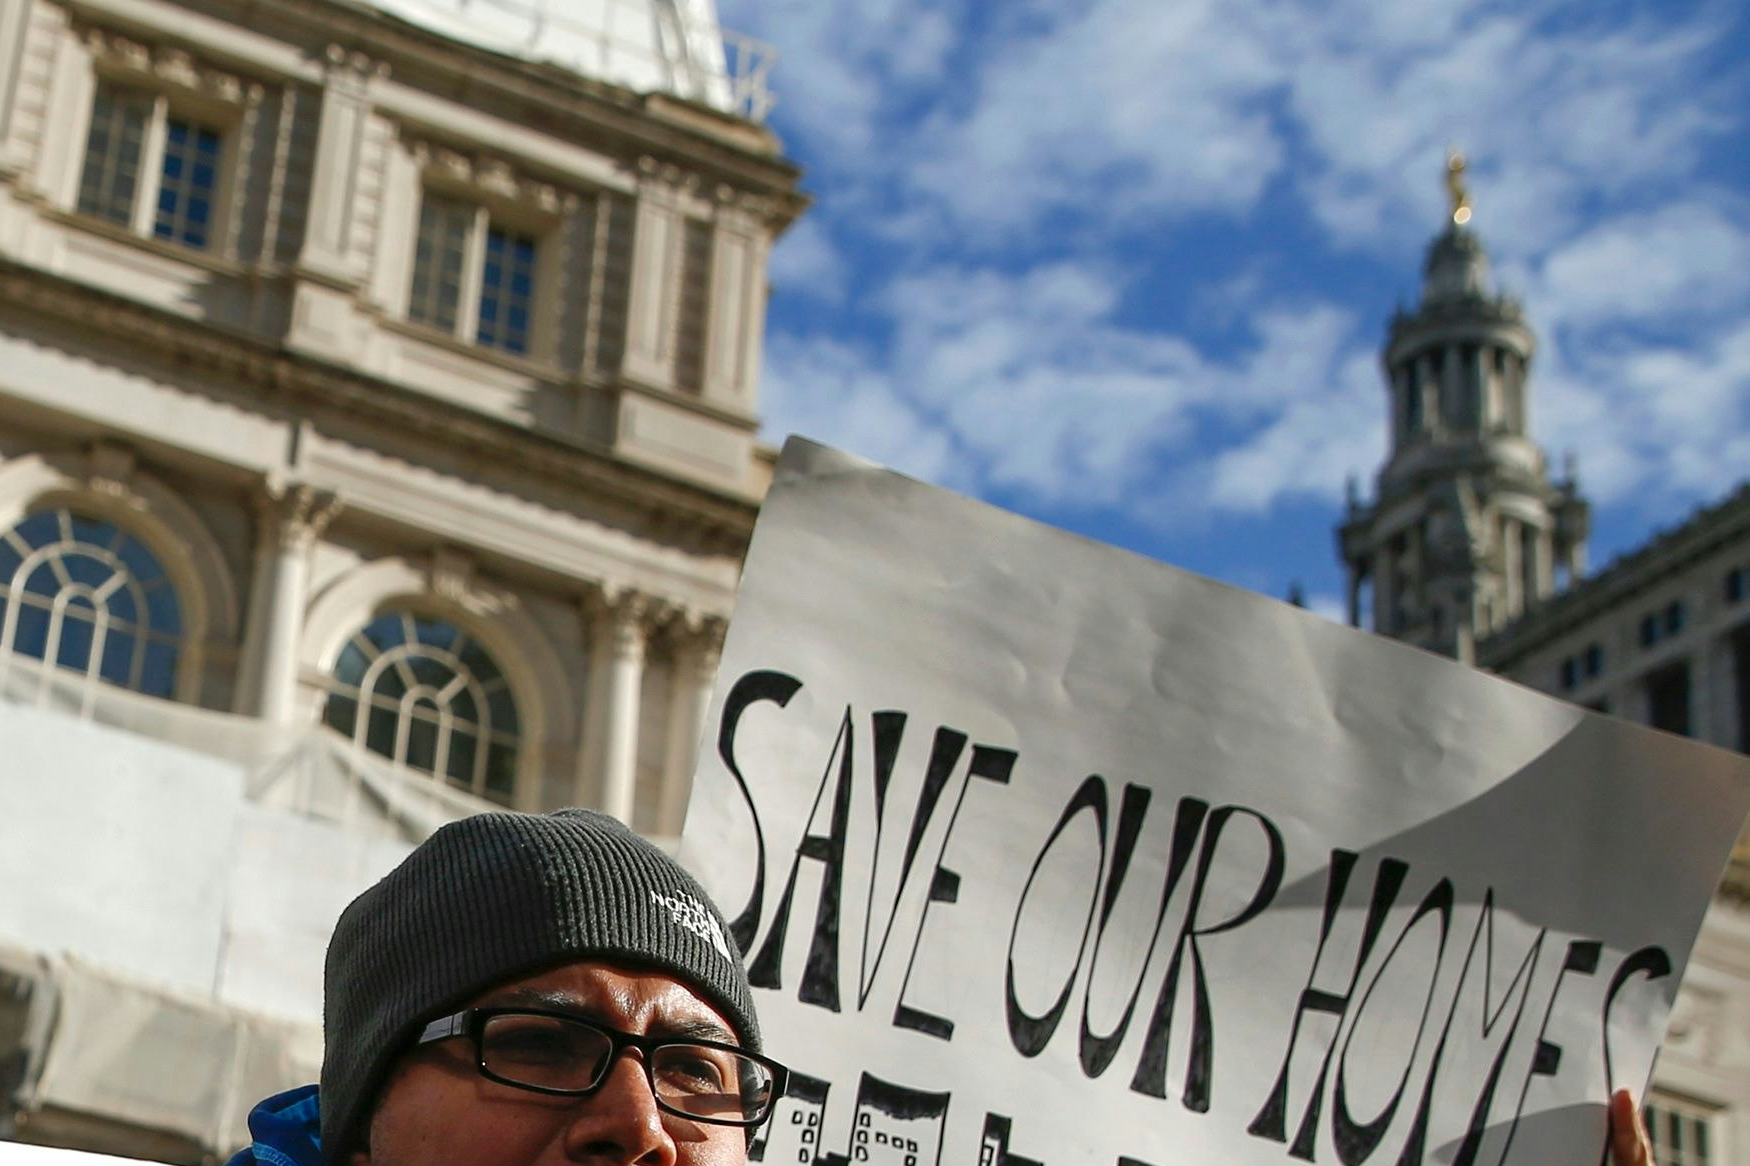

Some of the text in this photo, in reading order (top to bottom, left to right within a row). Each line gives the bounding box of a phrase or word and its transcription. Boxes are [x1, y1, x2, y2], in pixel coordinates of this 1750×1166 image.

[676, 889, 707, 917] THE
[718, 670, 1019, 1041] SAVE
[1005, 773, 1287, 1113] OUR
[650, 890, 711, 931] NORTH
[673, 912, 712, 945] FACE
